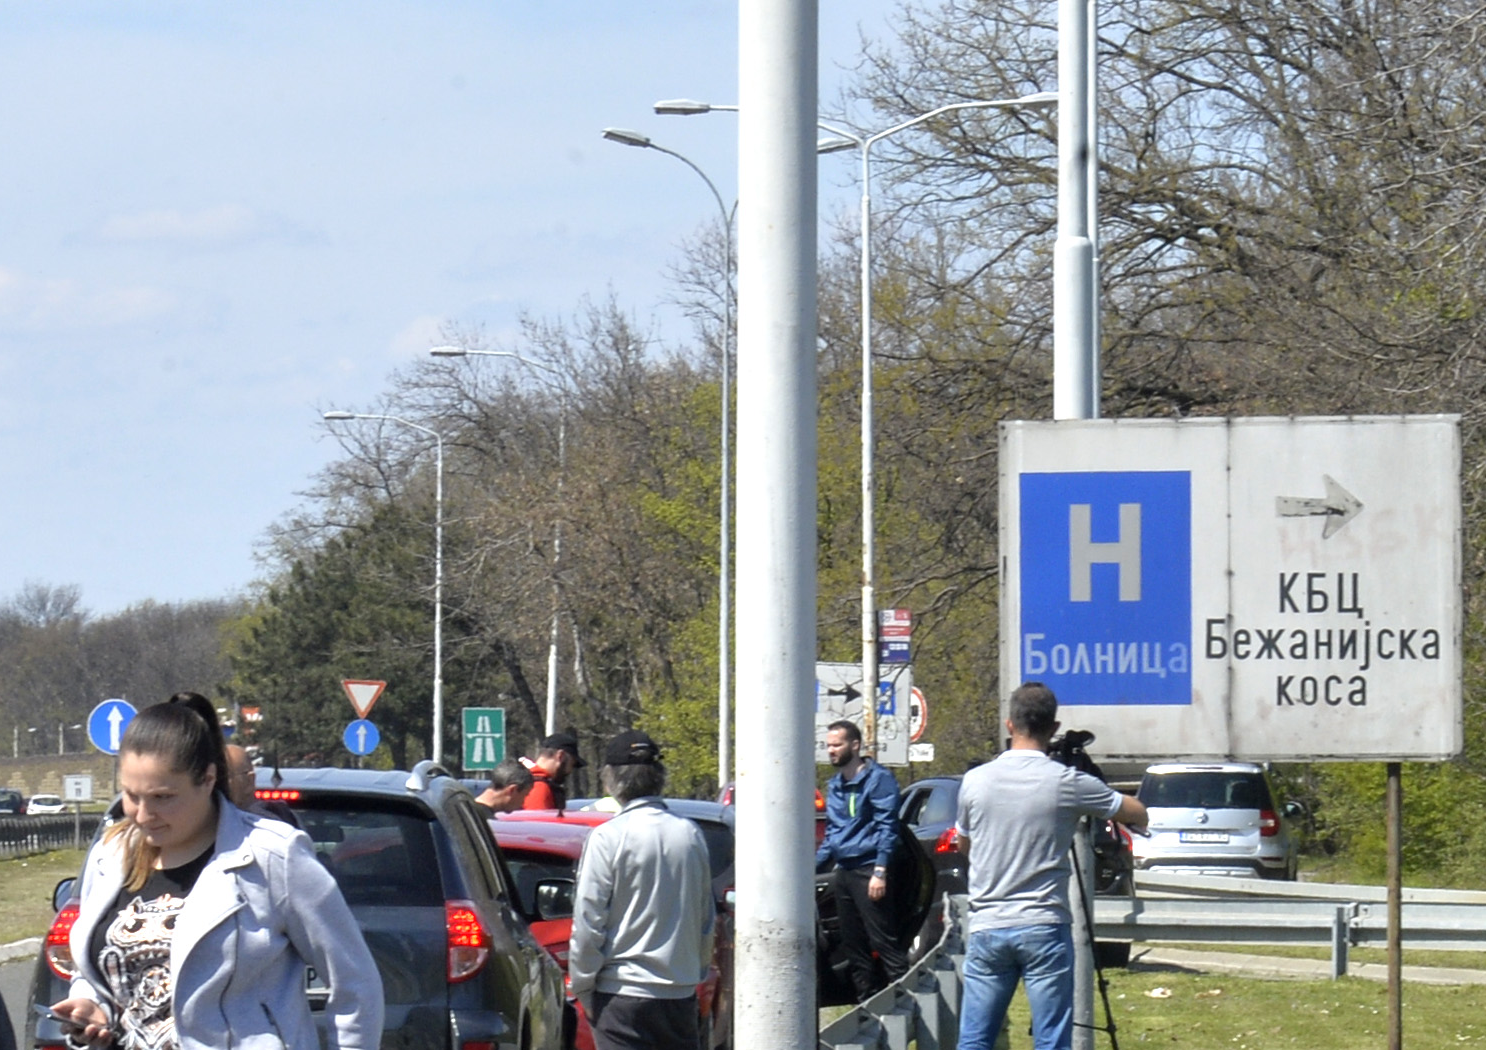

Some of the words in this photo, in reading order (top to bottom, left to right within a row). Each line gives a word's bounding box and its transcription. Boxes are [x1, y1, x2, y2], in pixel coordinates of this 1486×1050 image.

[1069, 503, 1142, 602] H
[1278, 572, 1364, 618] КБЦ
[1024, 633, 1188, 678] Болница
[1205, 618, 1441, 671] Бежанијска
[1276, 674, 1368, 706] коса
